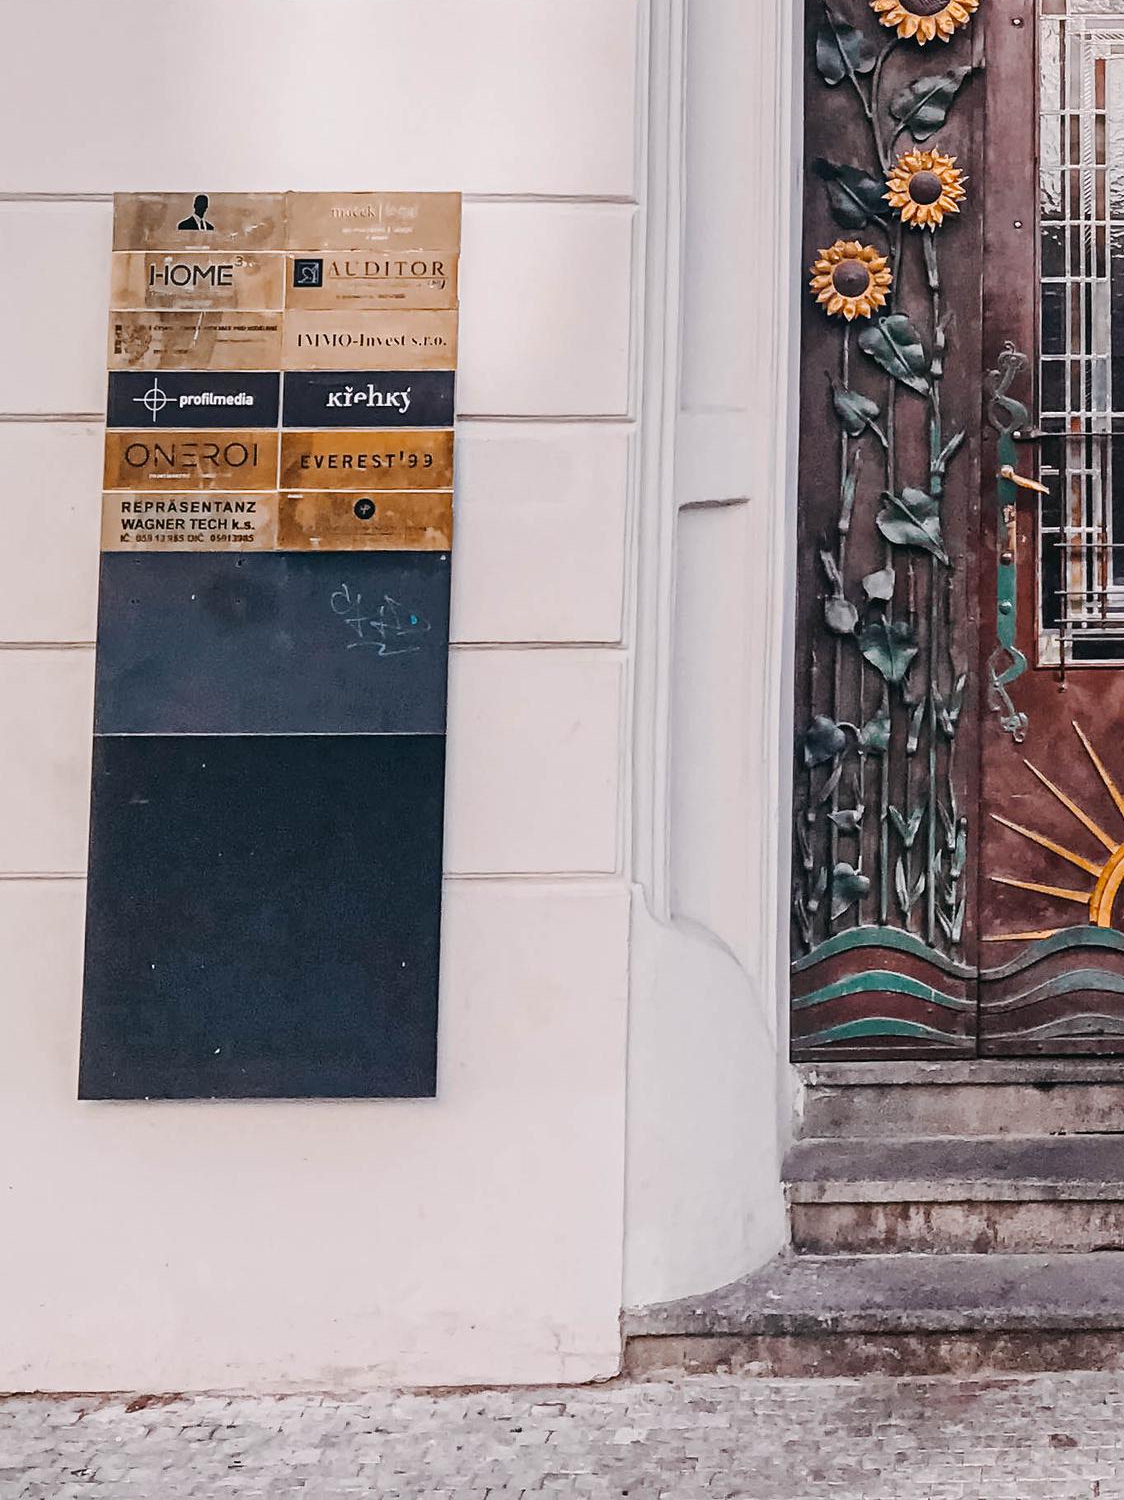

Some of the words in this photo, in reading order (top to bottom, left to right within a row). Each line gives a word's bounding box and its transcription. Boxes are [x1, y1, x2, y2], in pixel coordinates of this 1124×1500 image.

[149, 264, 234, 287] HOME
[328, 261, 446, 277] AUDITOR
[297, 333, 405, 347] IMMO-Invest
[411, 336, 447, 347] s.r.o.
[179, 392, 254, 408] profilmedia
[125, 443, 258, 468] ONEROI
[300, 451, 433, 469] EVEREST'99
[121, 499, 257, 513] REPRÄSENTANZ
[121, 518, 186, 530] WAGNER
[189, 518, 227, 530] TECH
[231, 518, 255, 530] k.s.
